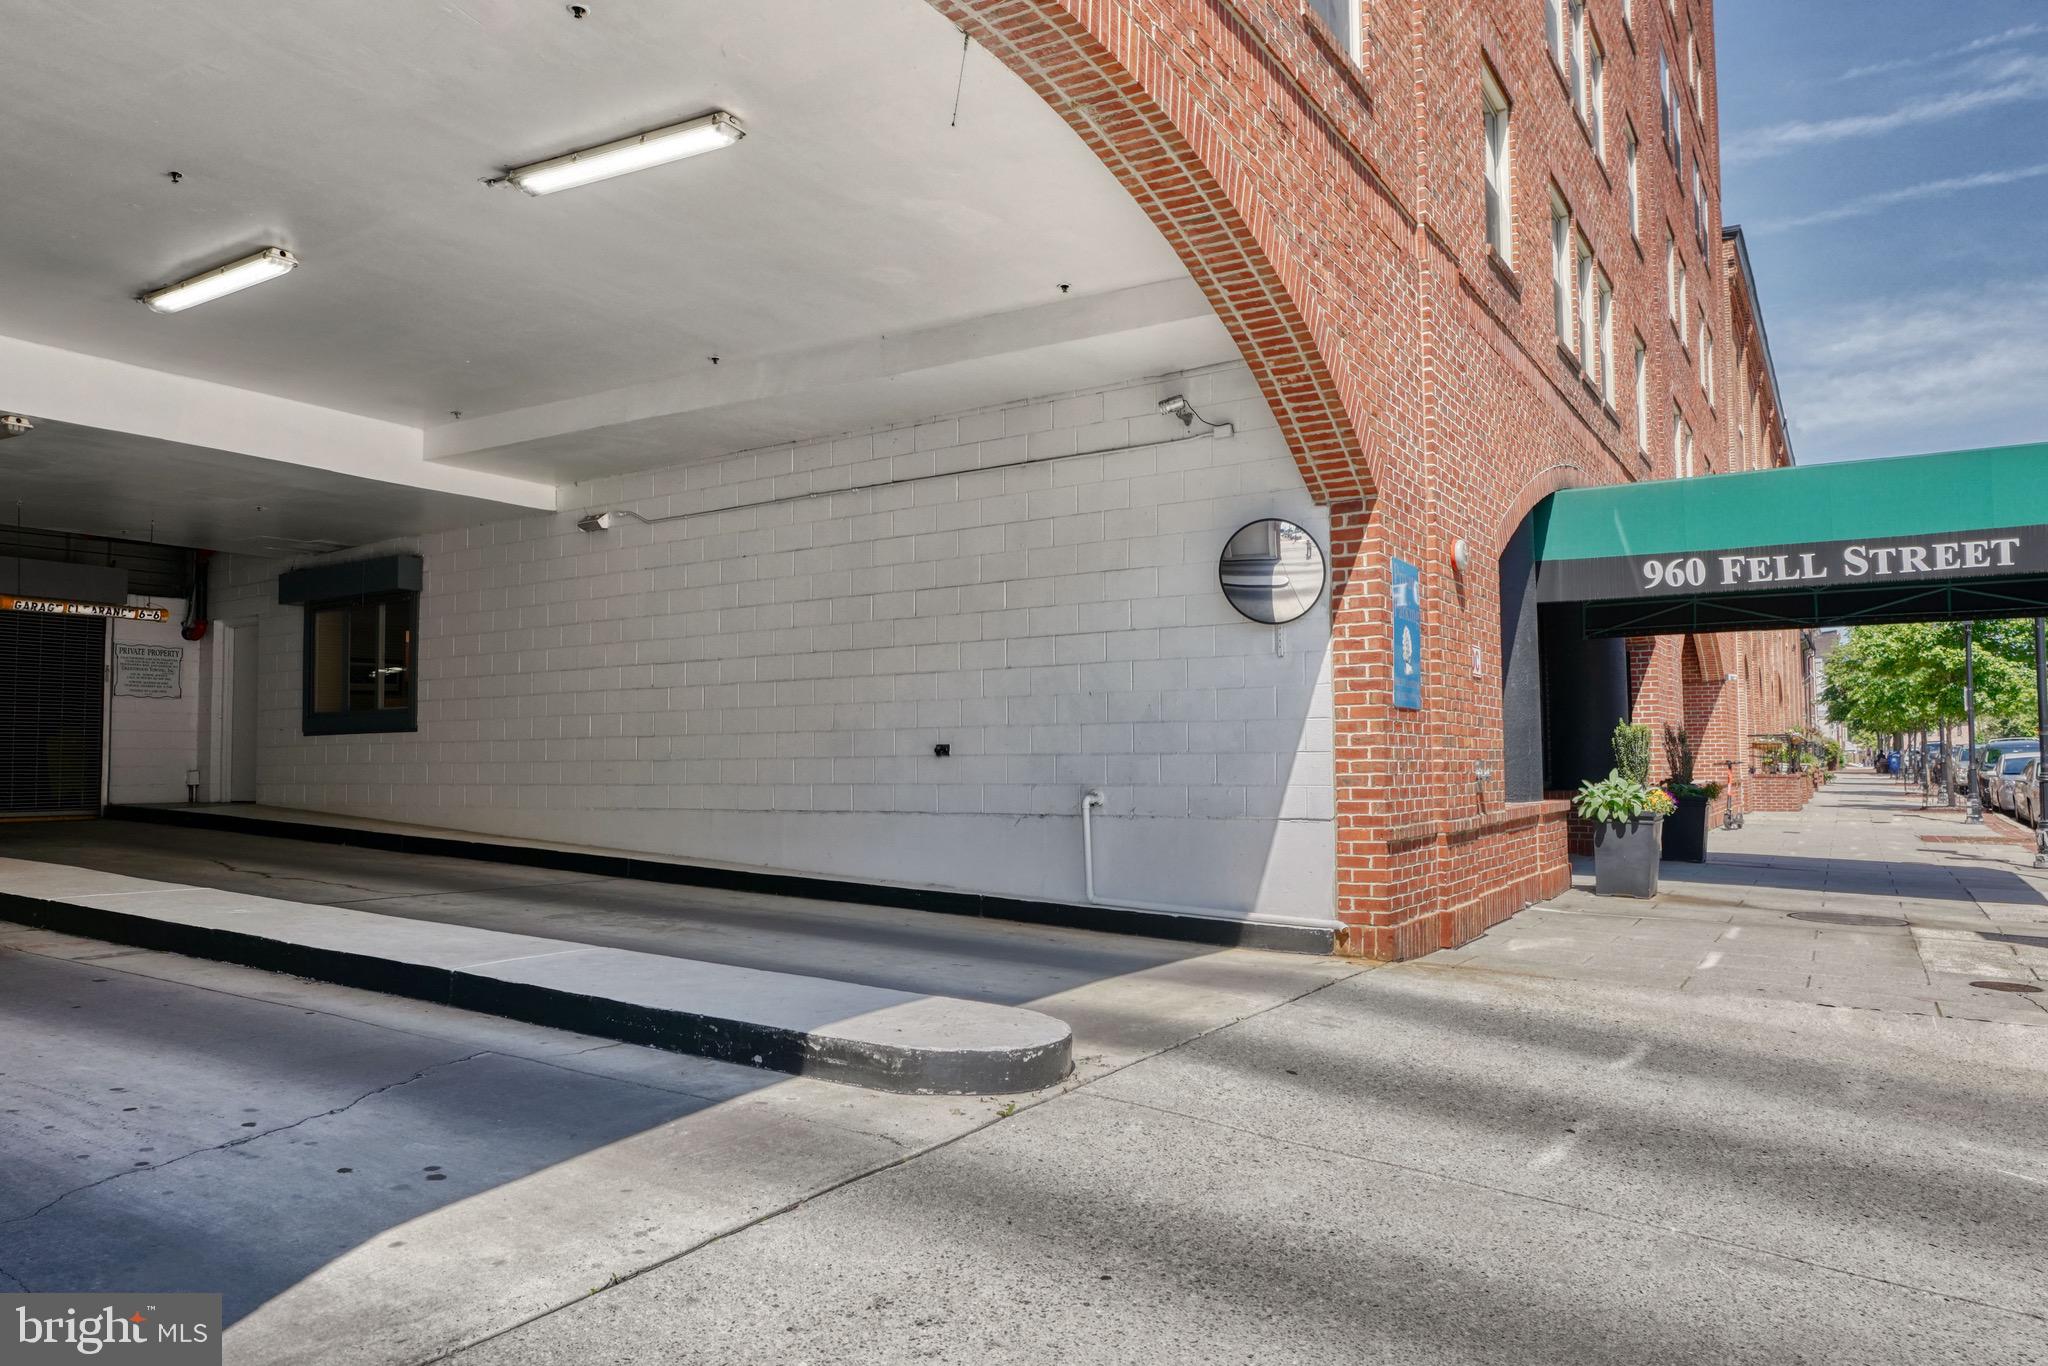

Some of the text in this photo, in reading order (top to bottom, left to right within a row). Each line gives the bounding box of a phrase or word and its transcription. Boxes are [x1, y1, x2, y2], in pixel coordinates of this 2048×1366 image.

[1643, 537, 2021, 589] 960 FELL STREET
[14, 600, 160, 620] GARAG CLARANC 6-6
[119, 647, 180, 658] PRIVATE PROPERTY
